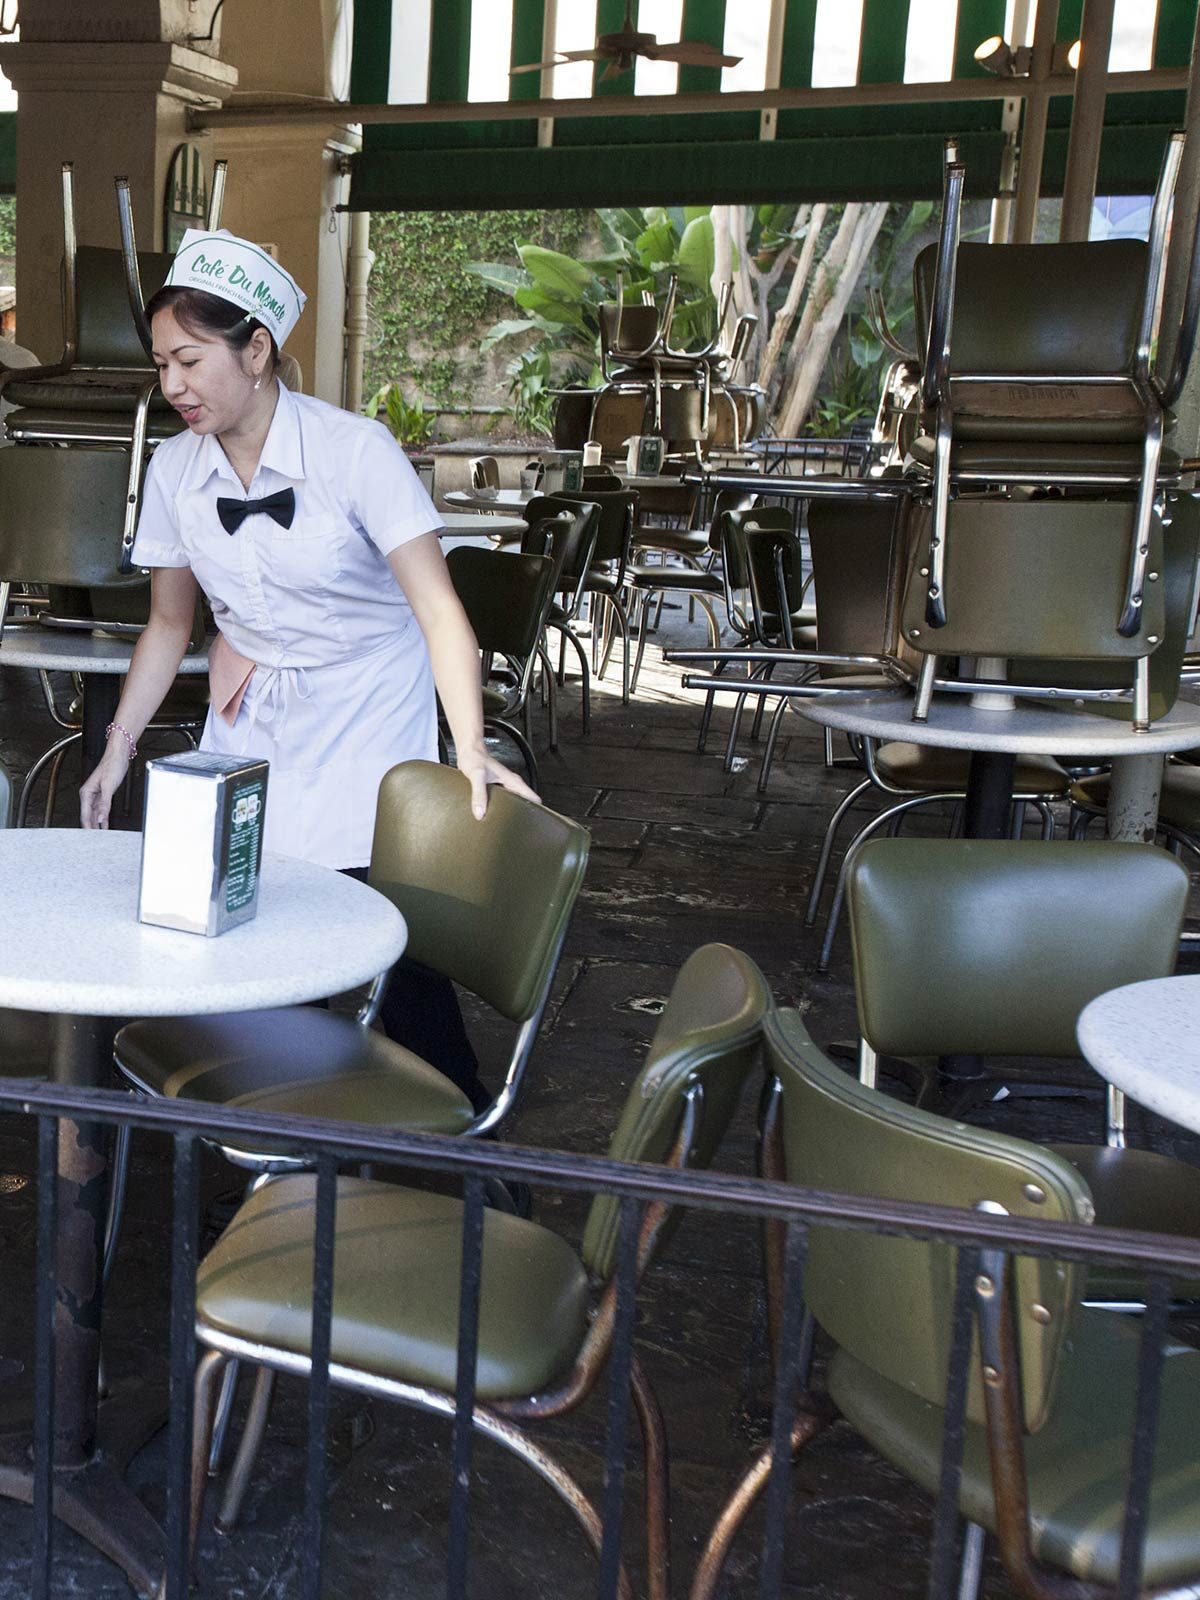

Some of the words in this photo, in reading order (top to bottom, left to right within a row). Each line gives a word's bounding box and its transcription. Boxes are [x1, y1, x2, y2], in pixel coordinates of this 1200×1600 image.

[191, 254, 229, 279] Café
[228, 264, 253, 293] Du
[252, 280, 286, 324] Monde
